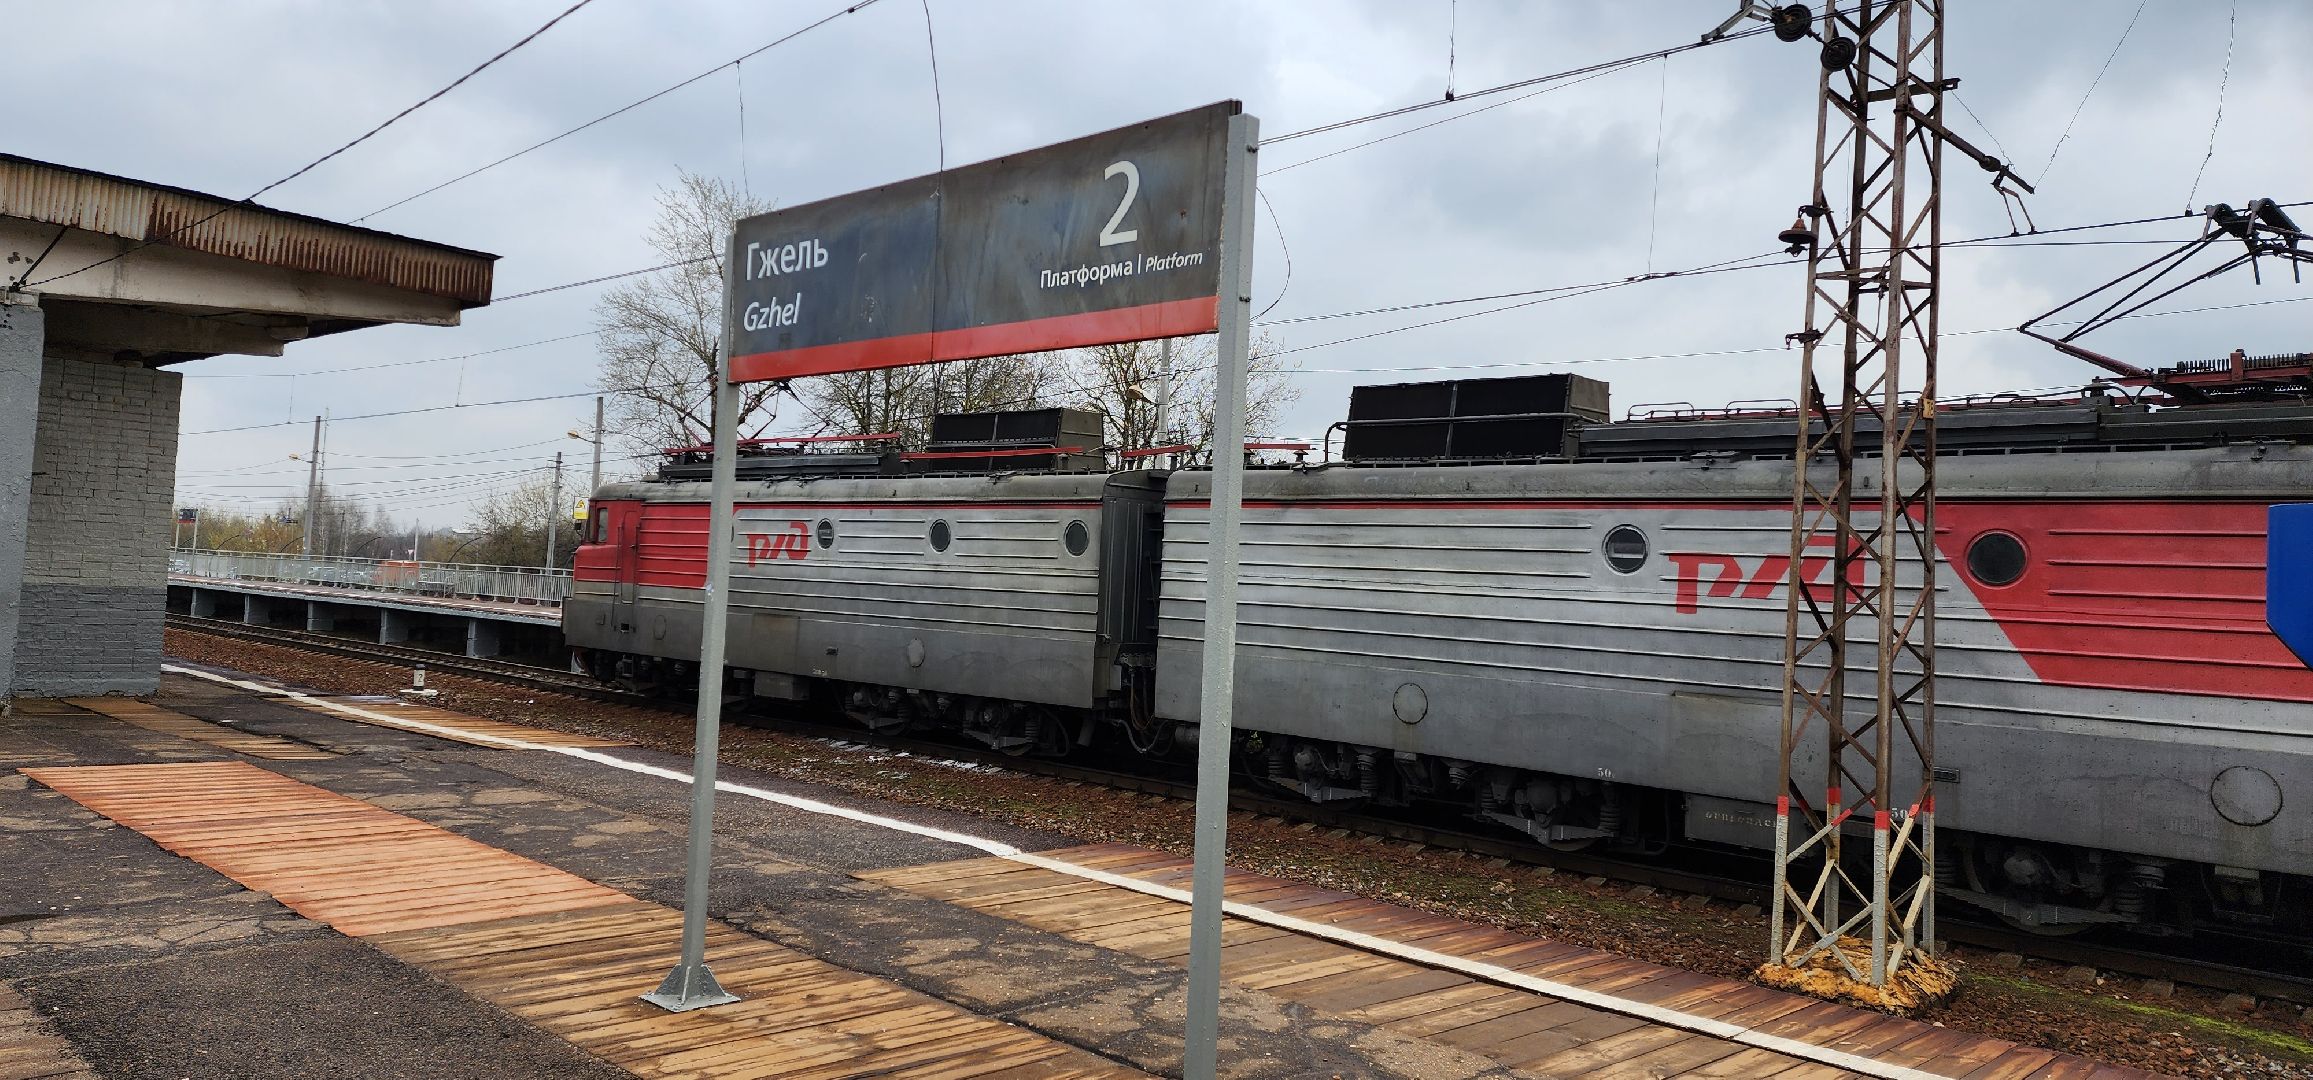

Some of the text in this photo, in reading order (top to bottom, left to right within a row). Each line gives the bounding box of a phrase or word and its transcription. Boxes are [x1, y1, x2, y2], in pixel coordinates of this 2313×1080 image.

[1099, 160, 1140, 247] 2
[746, 237, 829, 281] Гжель
[1040, 251, 1203, 289] Платформа Platform
[743, 292, 802, 332] Gzhel
